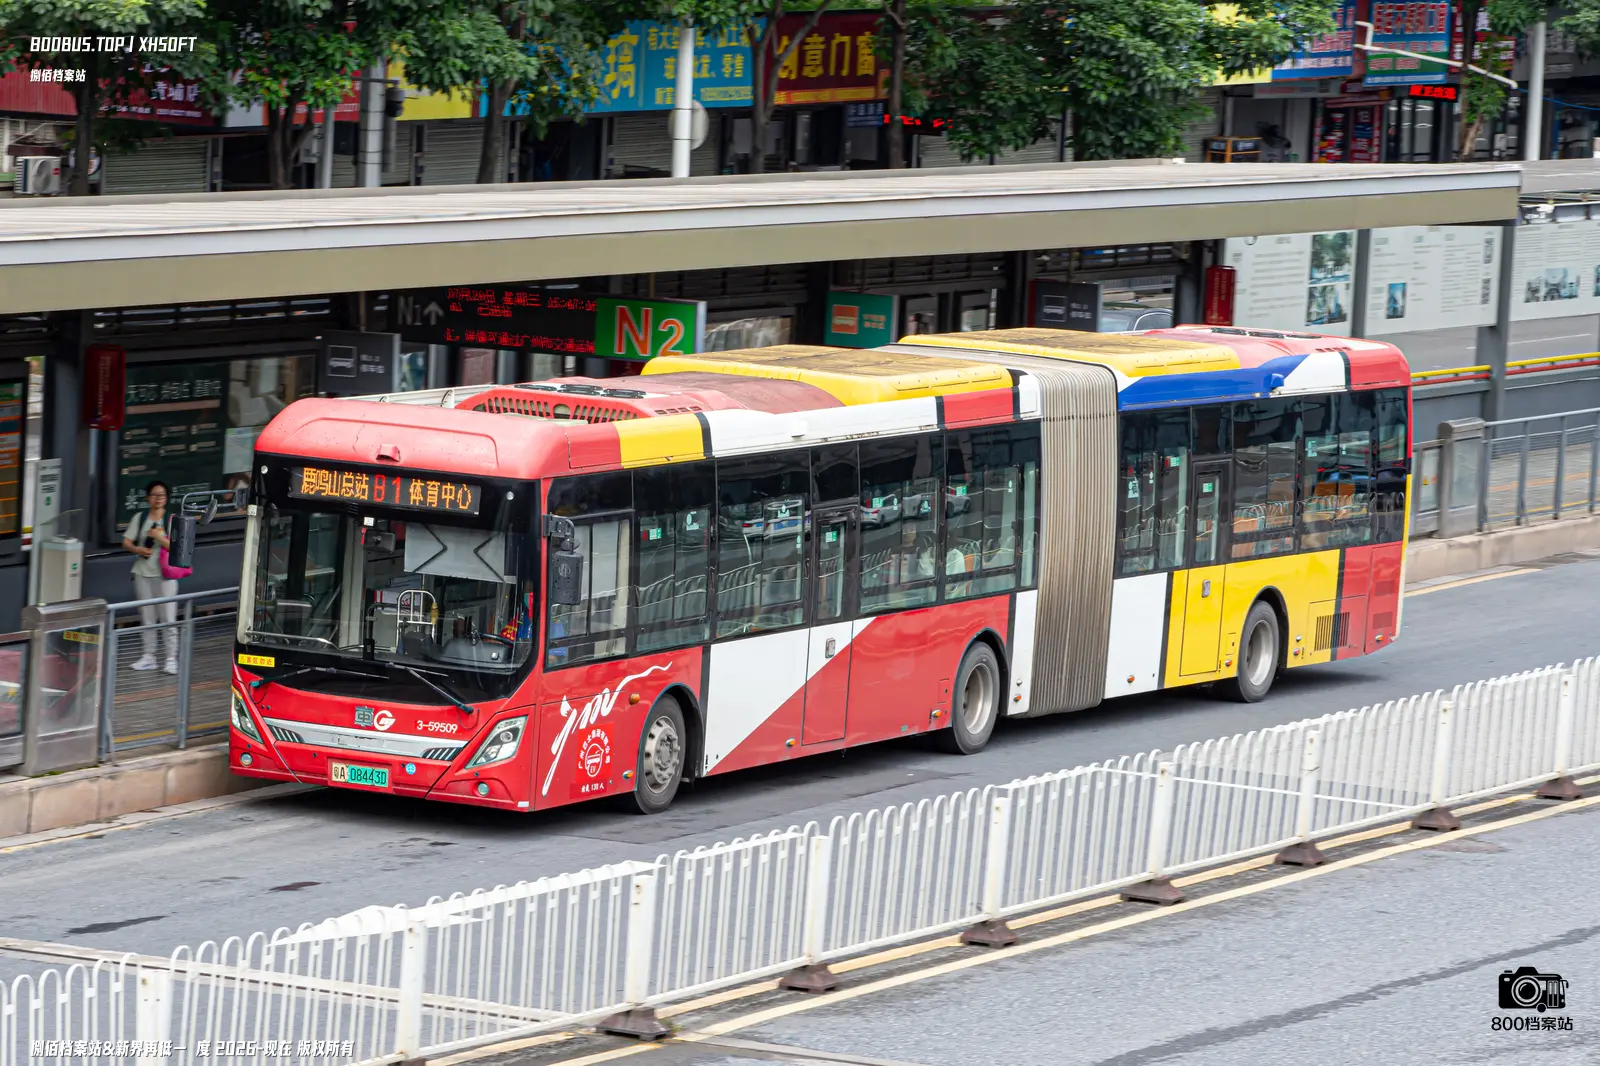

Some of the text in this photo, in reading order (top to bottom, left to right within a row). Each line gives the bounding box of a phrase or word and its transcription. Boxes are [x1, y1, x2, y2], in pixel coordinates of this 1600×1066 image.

[614, 305, 685, 357] N2
[301, 467, 472, 510] 鹿鸣山总站 B1 体育中心
[416, 720, 458, 734] 3-59509
